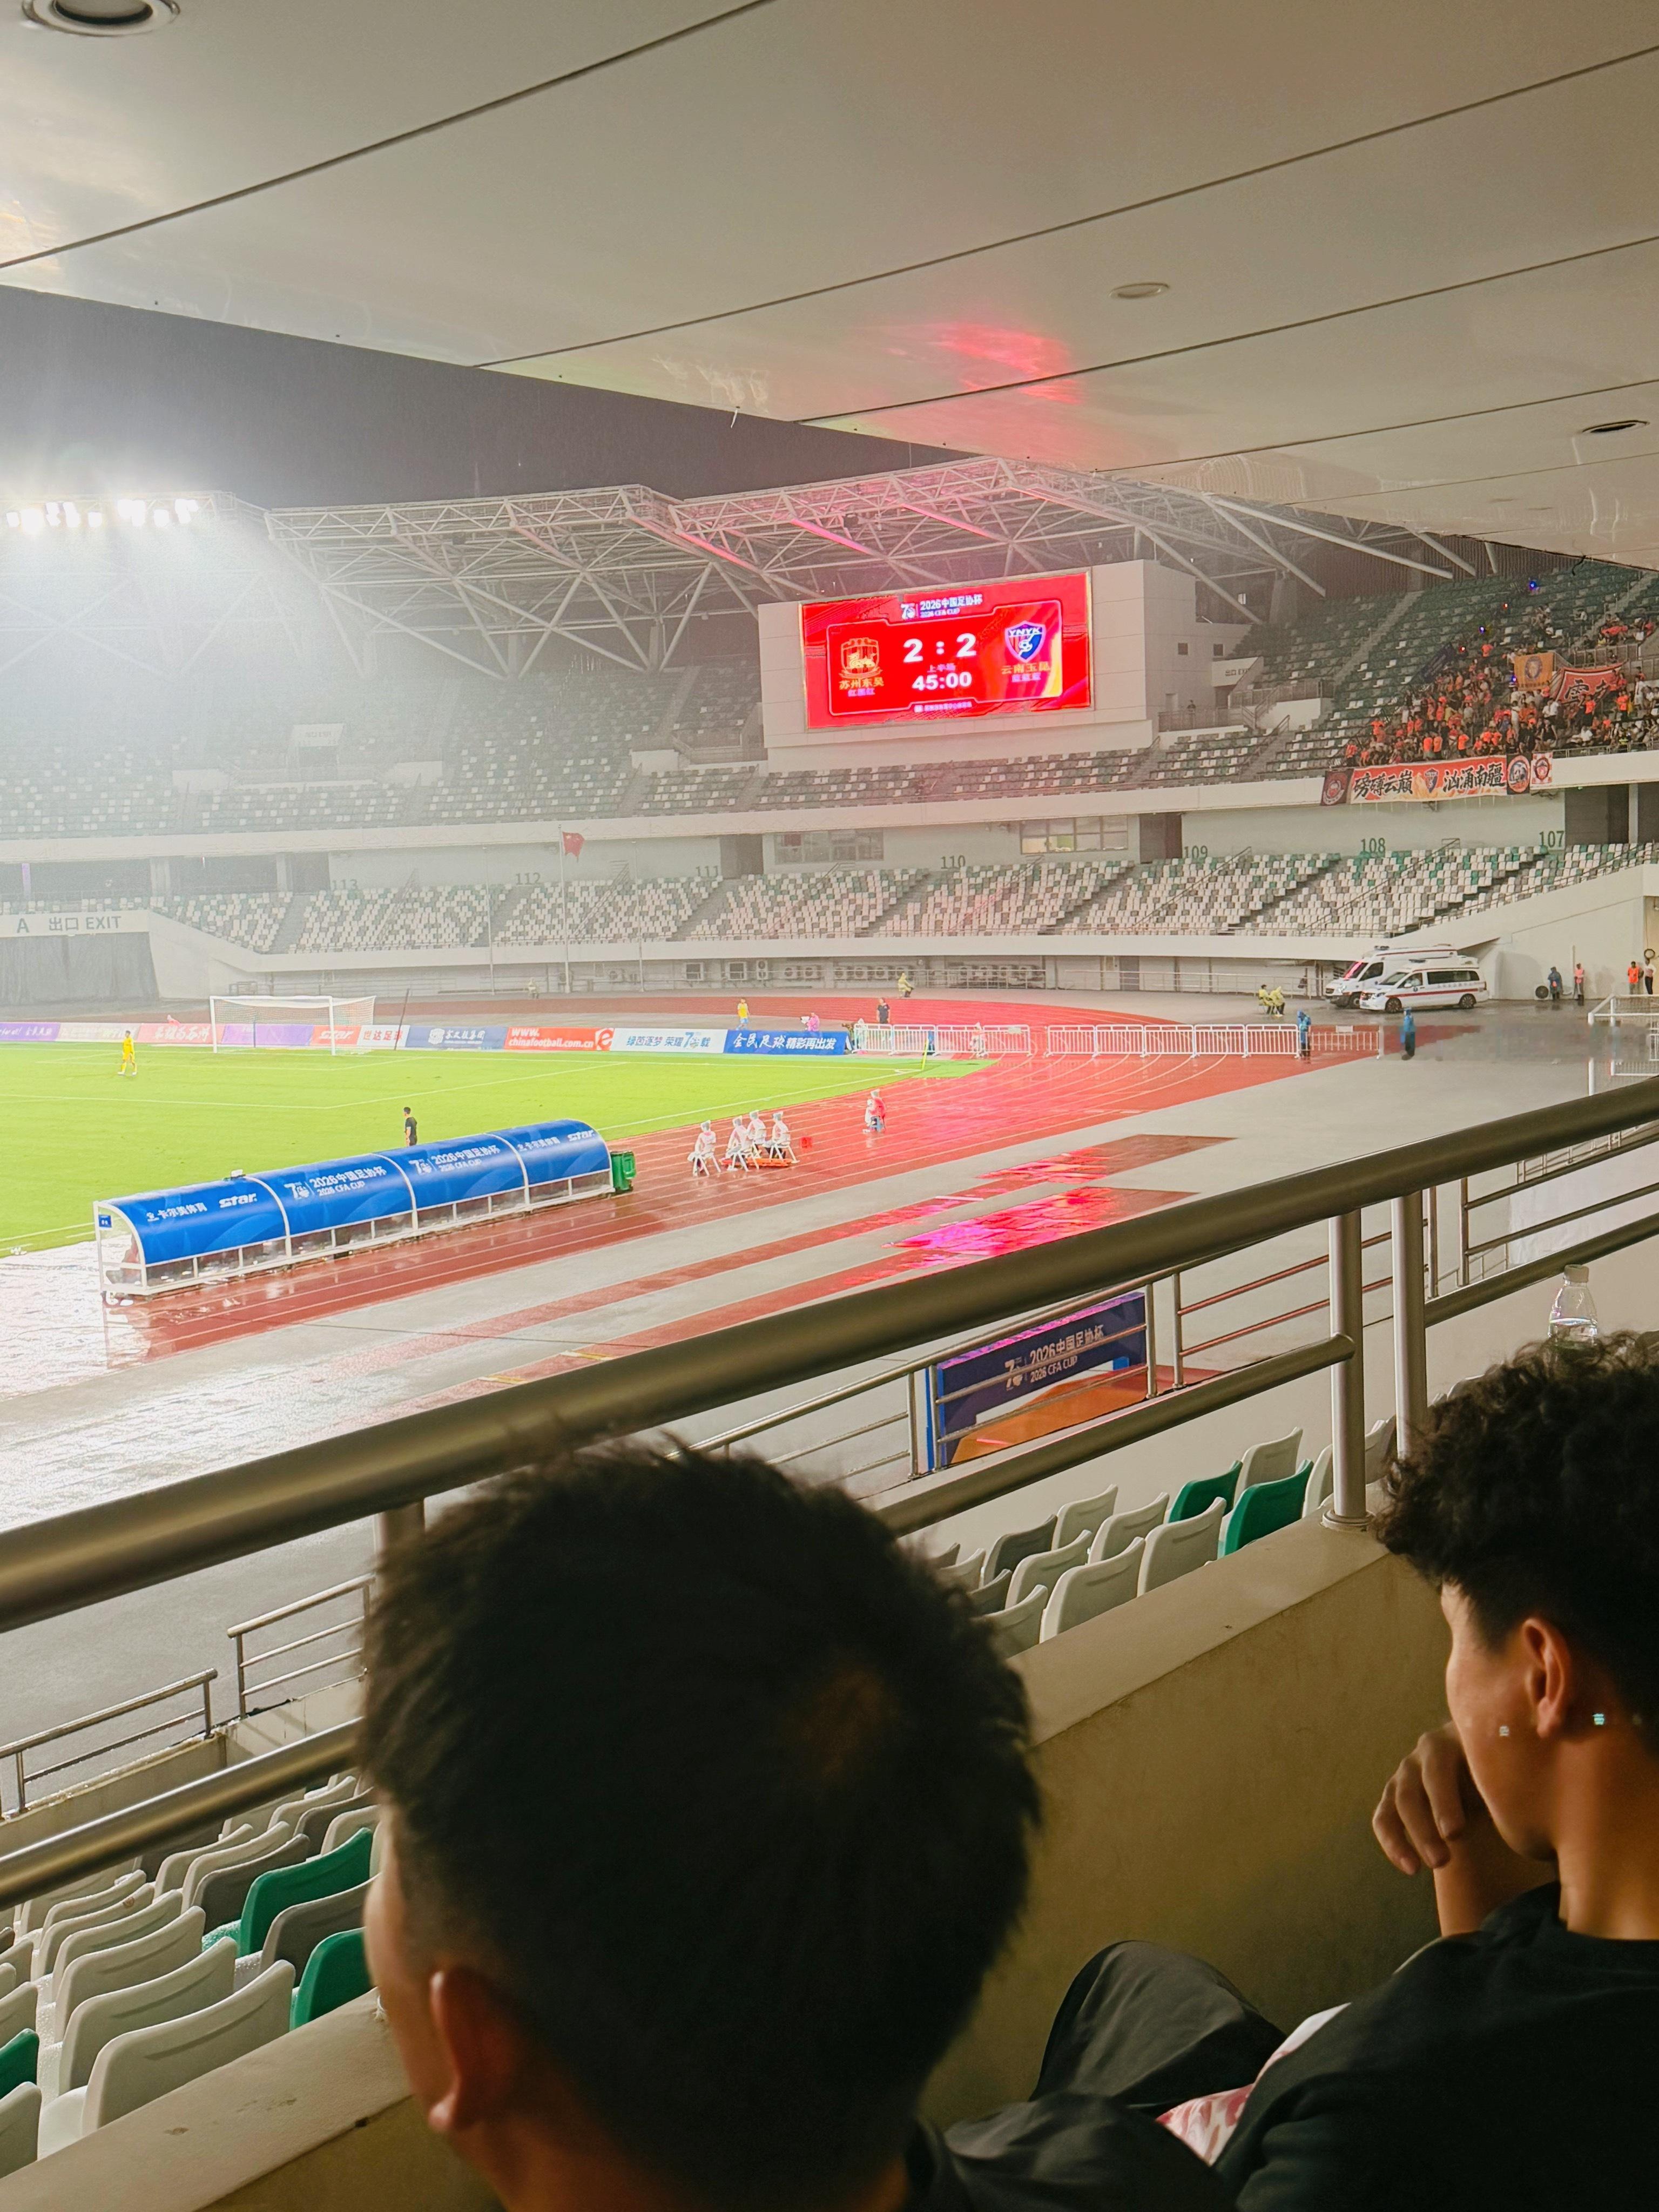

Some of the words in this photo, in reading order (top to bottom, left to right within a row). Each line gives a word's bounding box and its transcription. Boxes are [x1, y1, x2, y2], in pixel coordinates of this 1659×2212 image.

[1008, 626, 1042, 636] YNYK
[903, 638, 923, 663] 2
[956, 633, 976, 657] 2
[839, 677, 884, 690] 苏州东吴
[912, 671, 972, 691] 45:00
[1443, 763, 1505, 792] 汹涌南疆
[1361, 838, 1386, 853] 108
[1539, 830, 1564, 847] 107
[1184, 845, 1208, 860] 109
[940, 855, 966, 869] 110
[515, 872, 541, 886] 112
[696, 865, 719, 878] 111
[332, 879, 358, 890] 113
[17, 918, 29, 933] A
[49, 917, 79, 931] 出口
[86, 916, 122, 929] EXIT
[509, 1037, 594, 1048] chinafootball.com.cn
[431, 1145, 501, 1165] 2026中国足协杯
[309, 1165, 387, 1188] 2026中国足协杯
[335, 1184, 350, 1193] CFA
[350, 1181, 366, 1189] CUP
[1029, 1324, 1105, 1365] 2026中国足协杯
[1030, 1366, 1048, 1383] 2026
[1048, 1361, 1063, 1375] CFA
[1063, 1355, 1078, 1370] CUP
